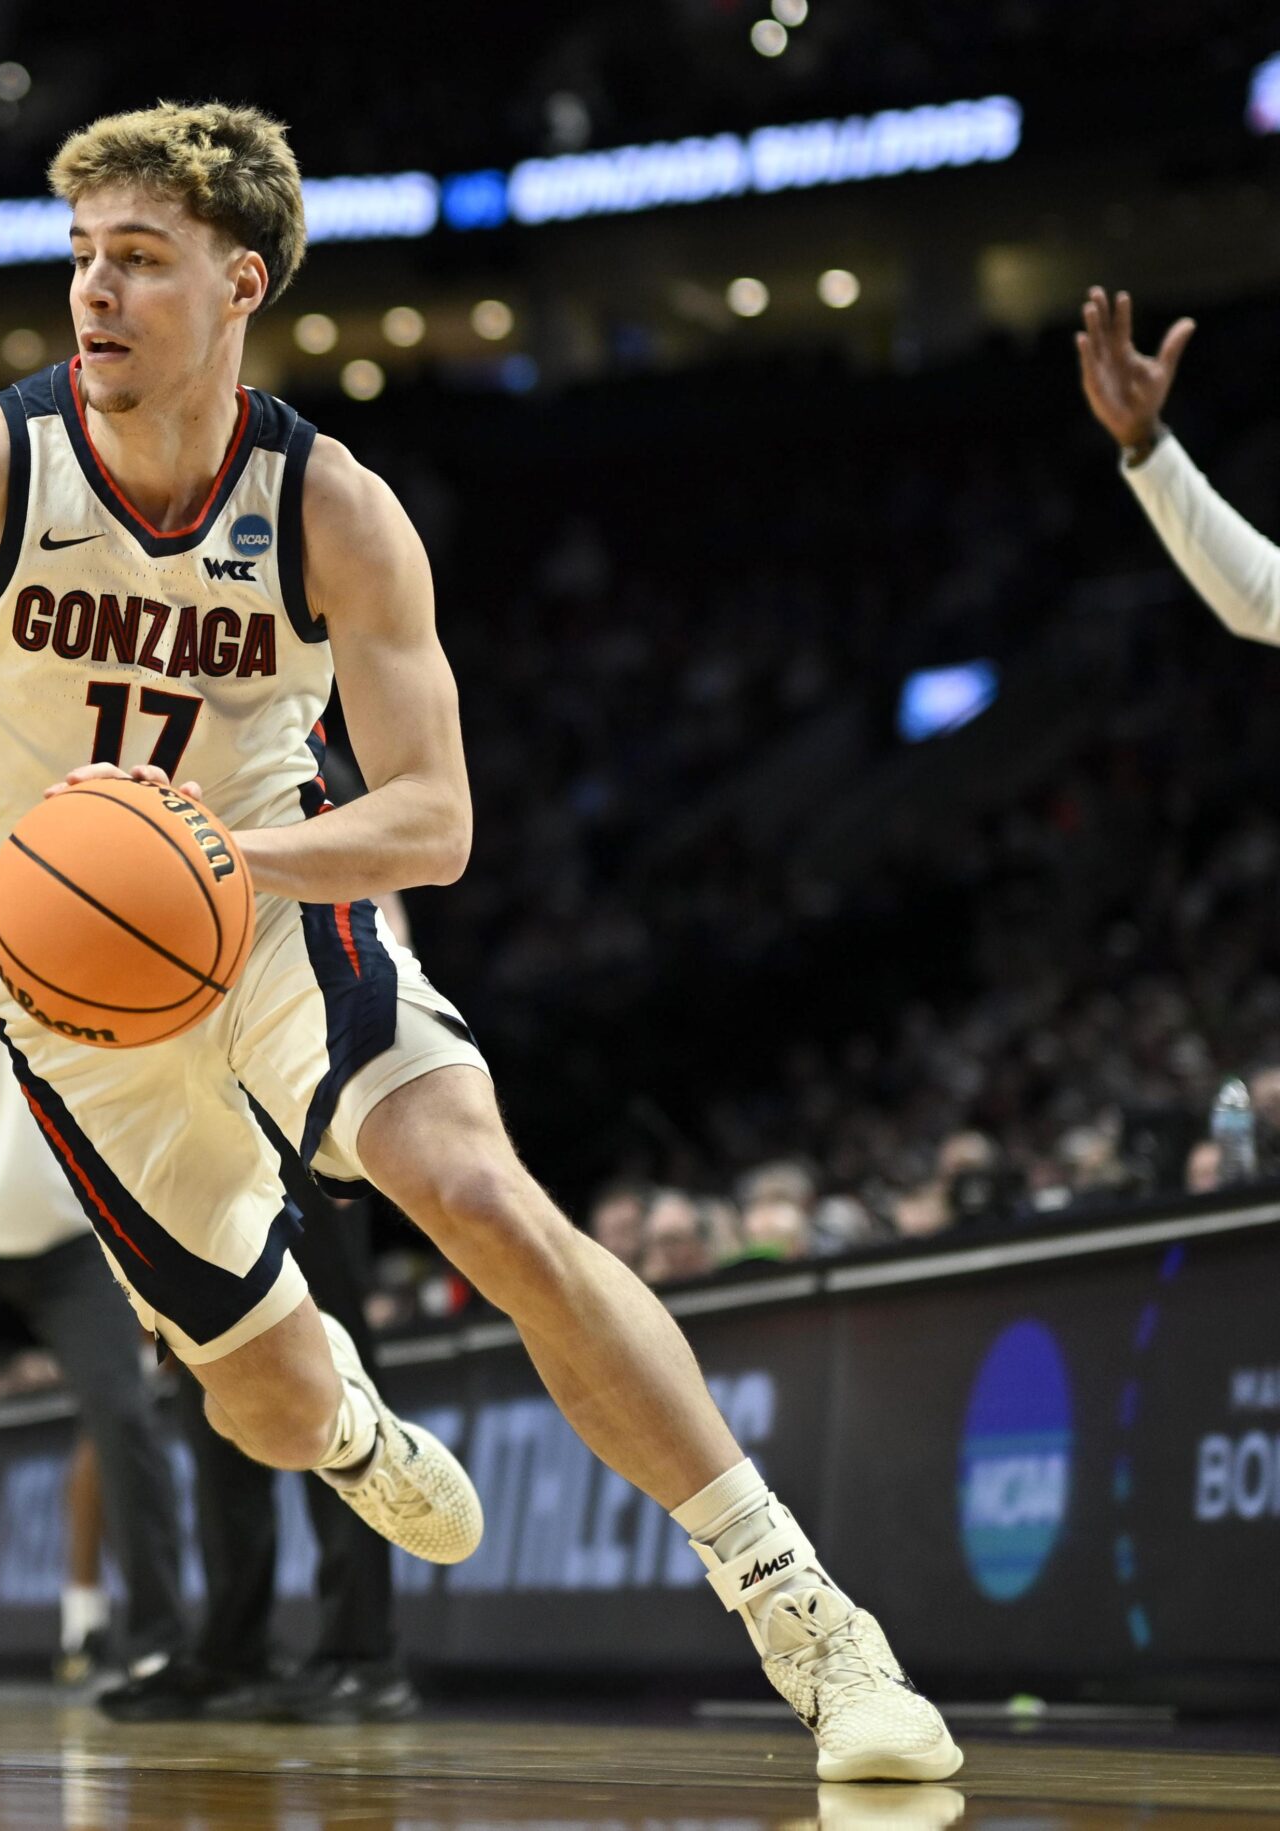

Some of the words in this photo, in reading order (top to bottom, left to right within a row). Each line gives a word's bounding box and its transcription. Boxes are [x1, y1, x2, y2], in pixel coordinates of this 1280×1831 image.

[202, 557, 257, 582] WCC
[236, 534, 270, 545] NCAA
[12, 584, 277, 678] GONZAGA
[86, 680, 204, 784] 17
[1195, 1429, 1280, 1521] BO
[739, 1549, 795, 1591] ZAMST
